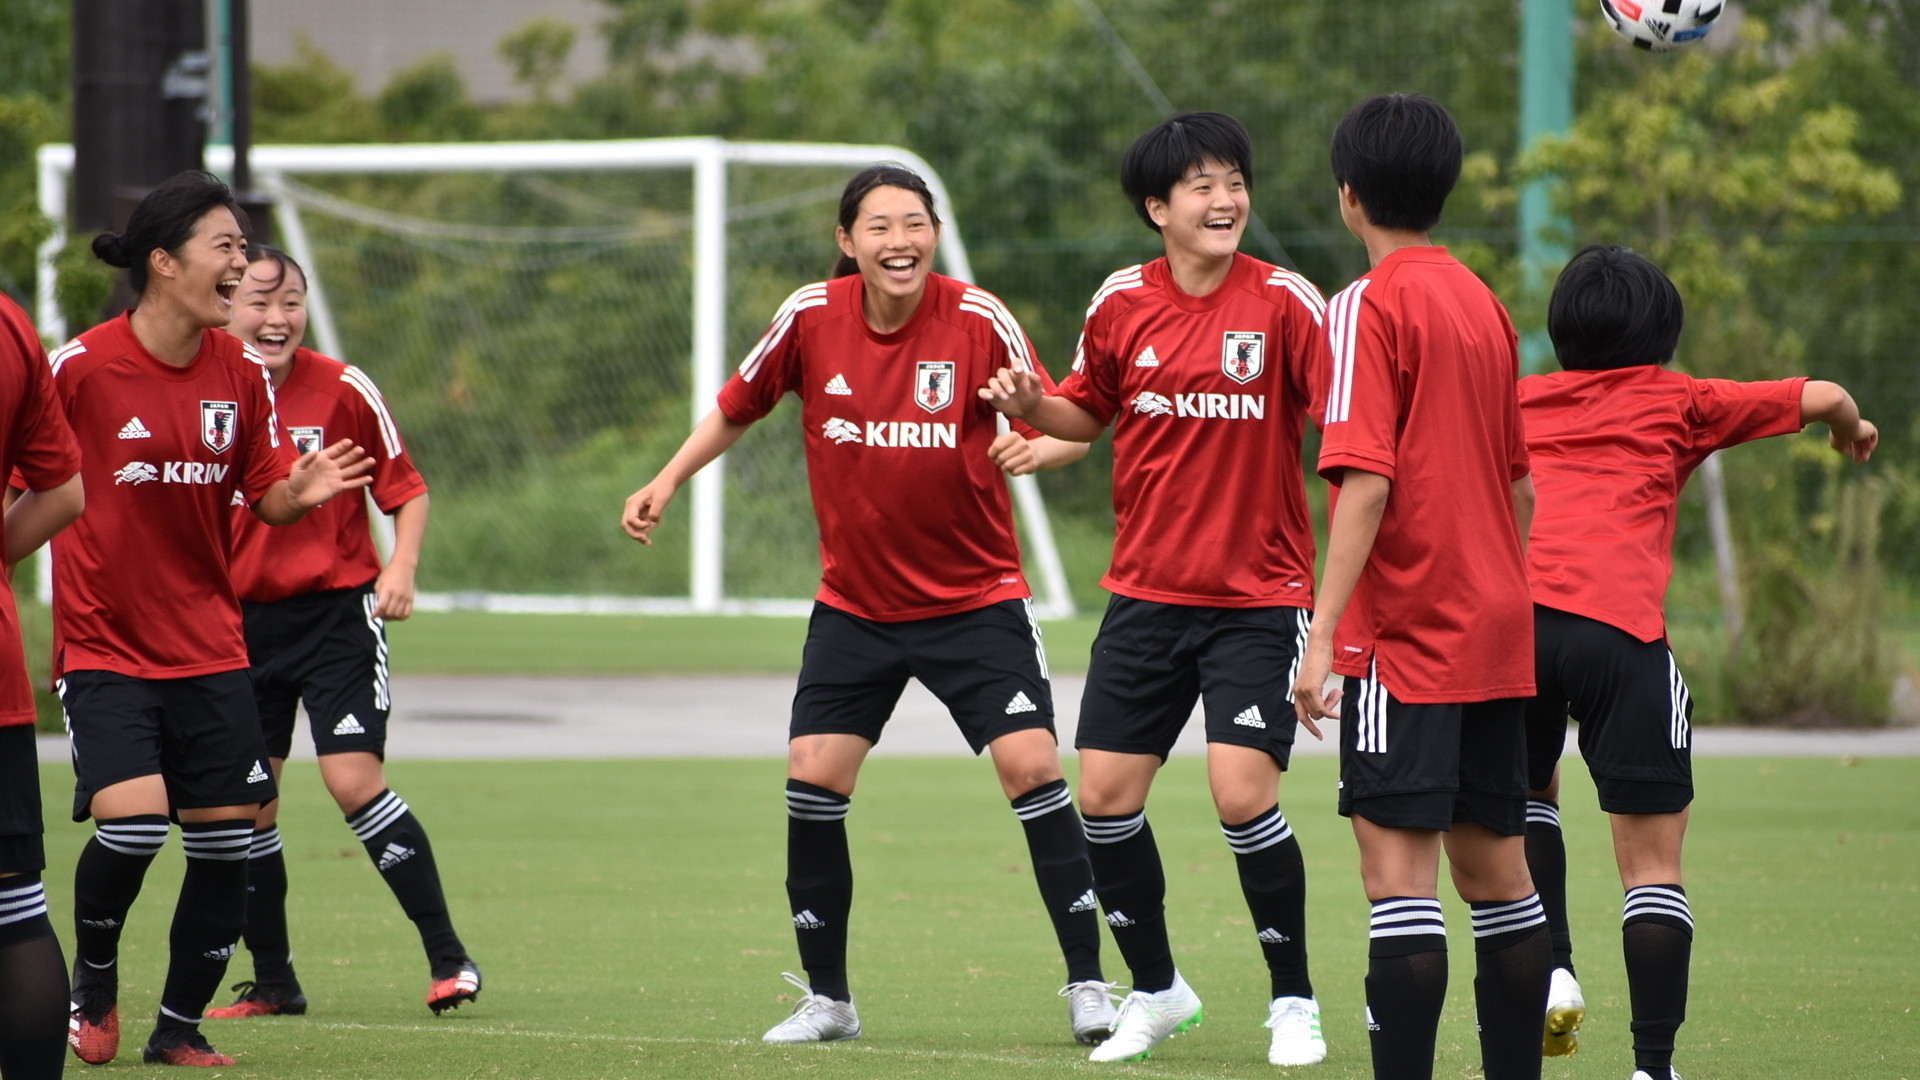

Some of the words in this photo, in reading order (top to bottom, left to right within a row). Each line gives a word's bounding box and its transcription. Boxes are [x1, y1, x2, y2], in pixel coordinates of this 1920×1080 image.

[1175, 393, 1265, 419] KIRIN
[118, 430, 151, 439] adidas
[866, 421, 956, 448] KIRIN
[163, 461, 229, 484] KIRIN
[1005, 704, 1038, 715] adidas
[1233, 716, 1266, 729] adidas
[333, 726, 365, 736] adidas
